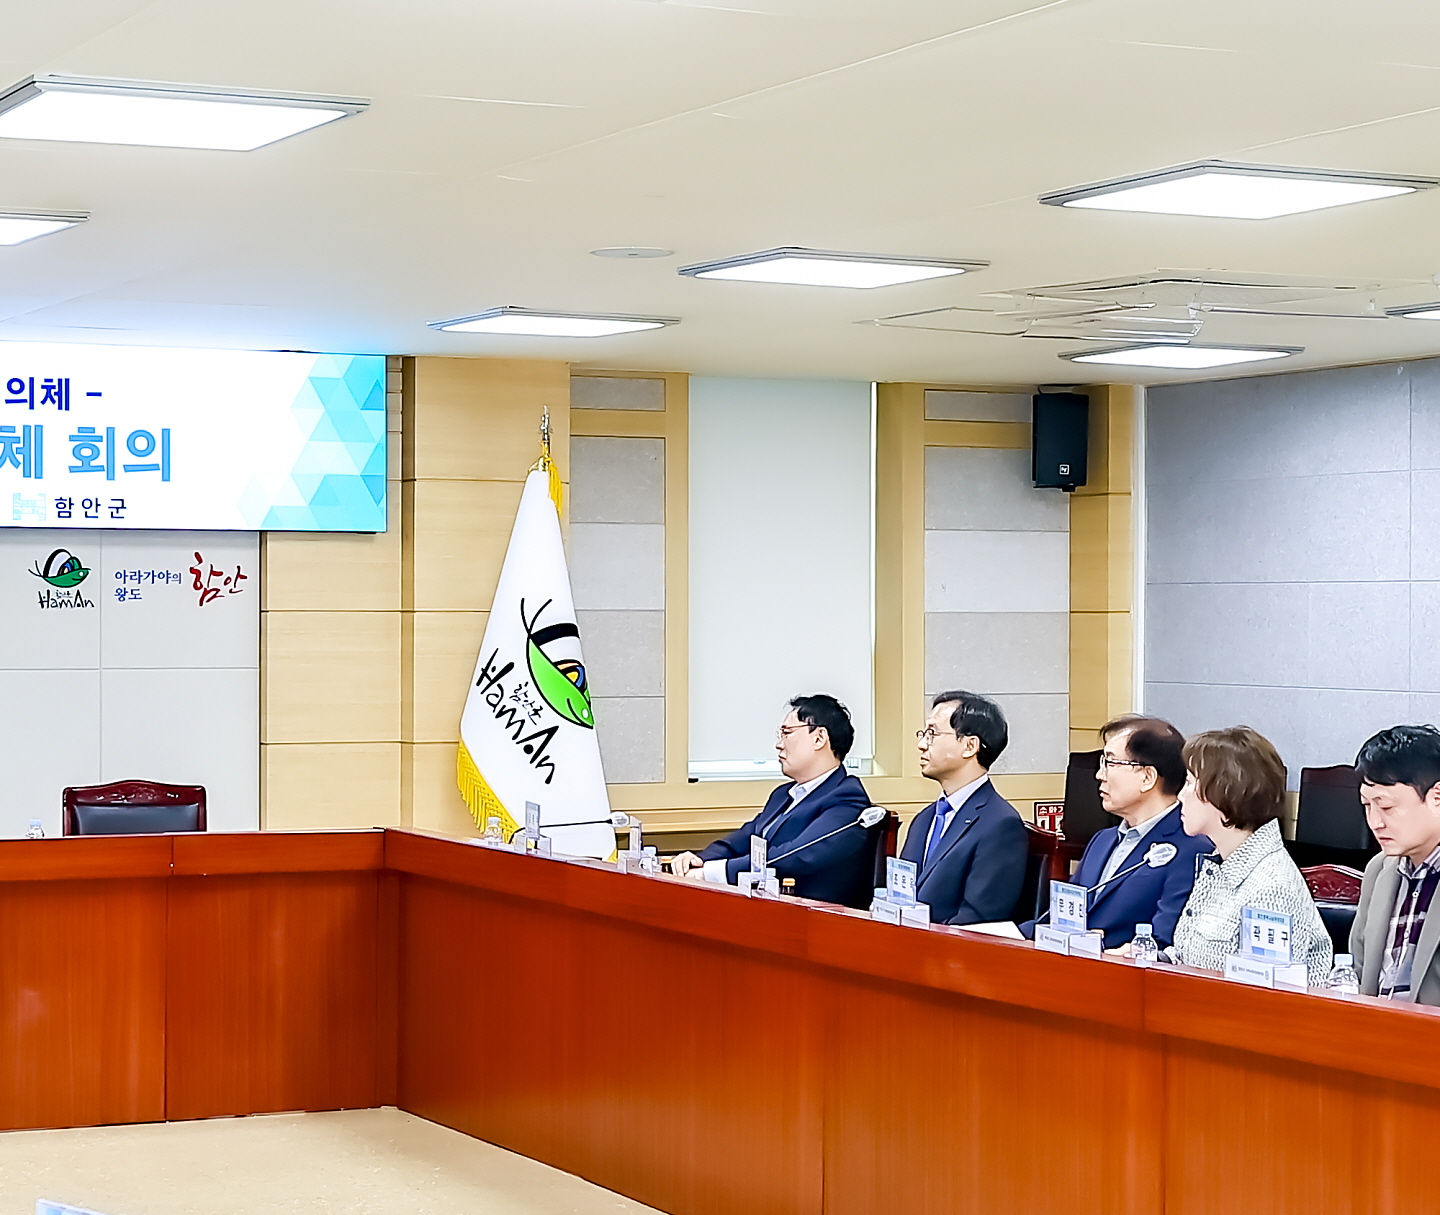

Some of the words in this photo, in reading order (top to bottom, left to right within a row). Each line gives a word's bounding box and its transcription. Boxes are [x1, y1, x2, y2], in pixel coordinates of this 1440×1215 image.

[68, 426, 171, 482] 회의
[114, 569, 182, 585] 아라가야의
[114, 587, 143, 602] 왕도
[189, 551, 248, 607] 함안
[37, 588, 95, 609] HamAn
[475, 647, 559, 785] HamAn
